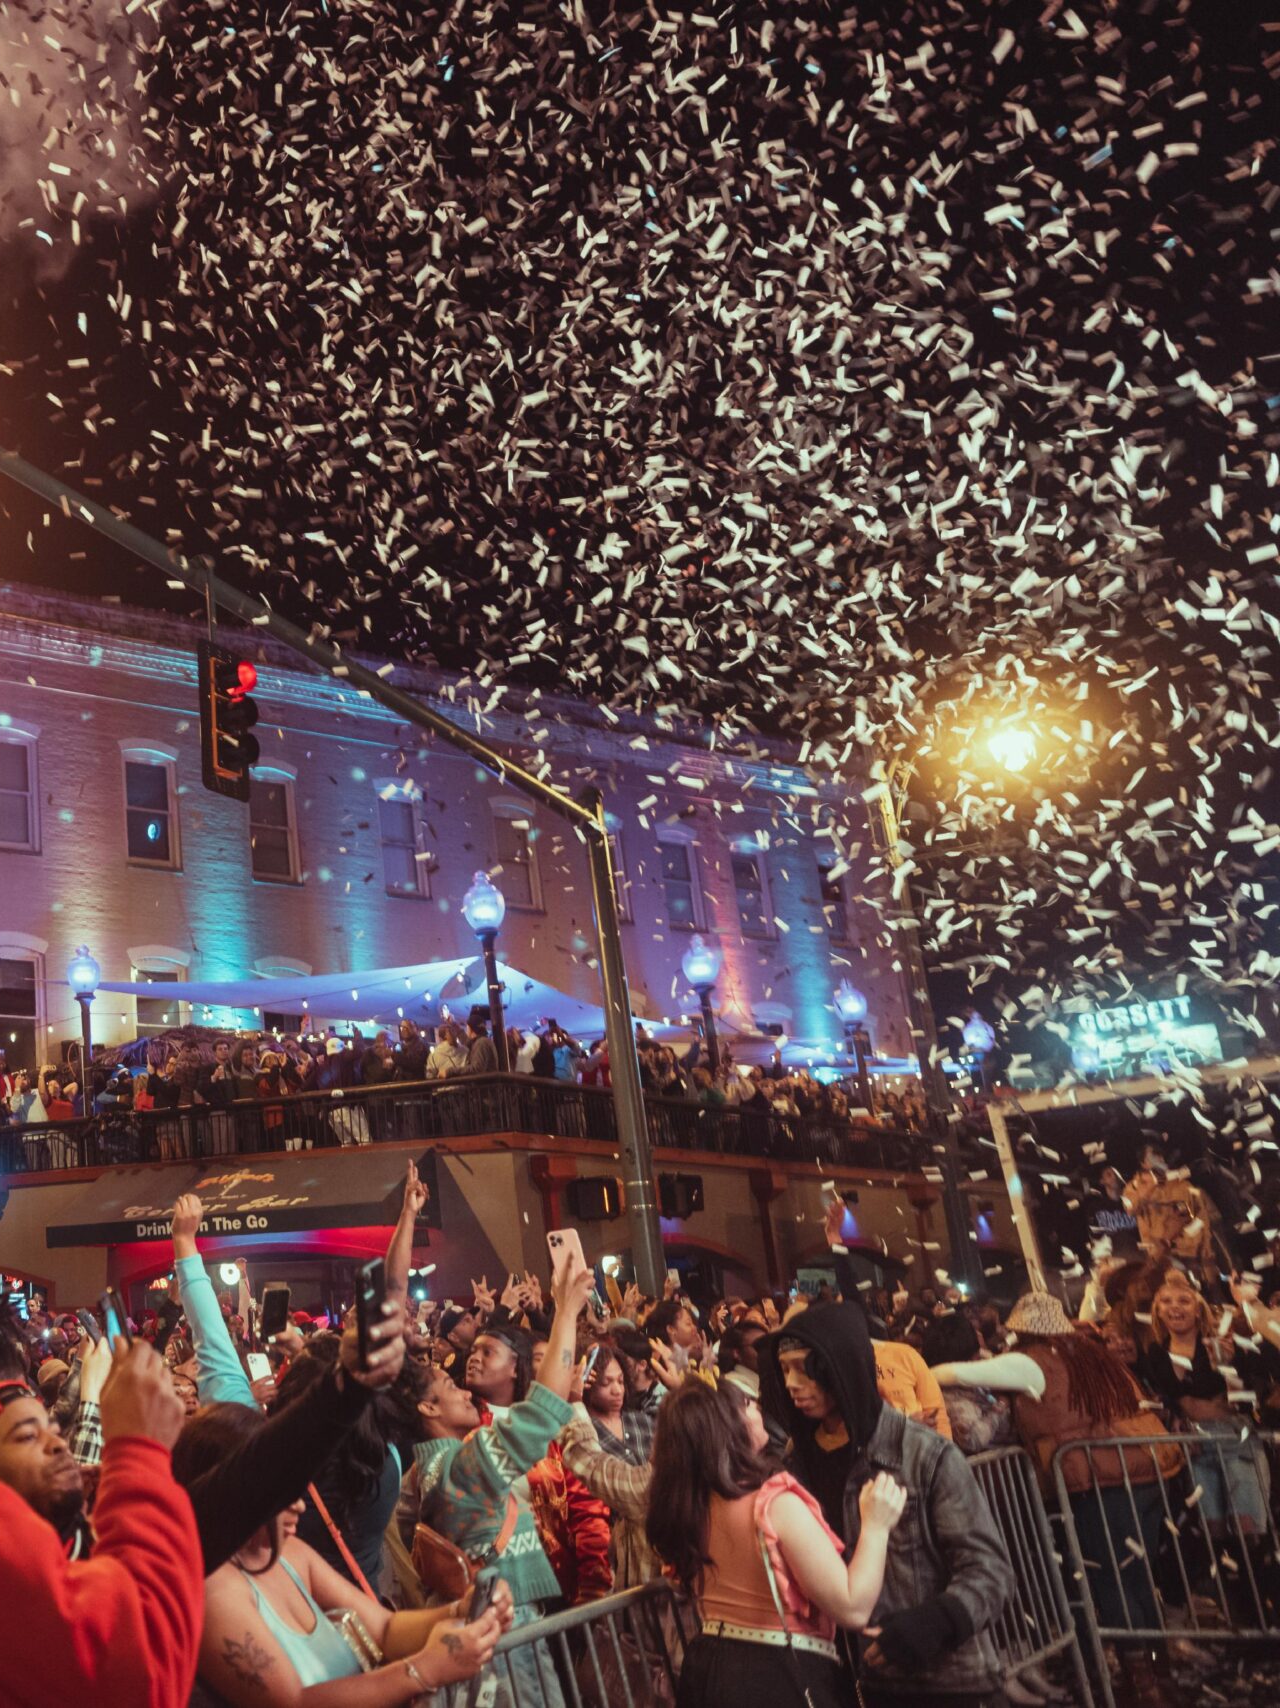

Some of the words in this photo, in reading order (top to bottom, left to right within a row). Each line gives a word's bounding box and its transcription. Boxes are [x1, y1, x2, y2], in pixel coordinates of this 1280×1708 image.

[136, 1220, 172, 1238] Drink
[212, 1216, 241, 1231] The
[246, 1214, 268, 1229] Go
